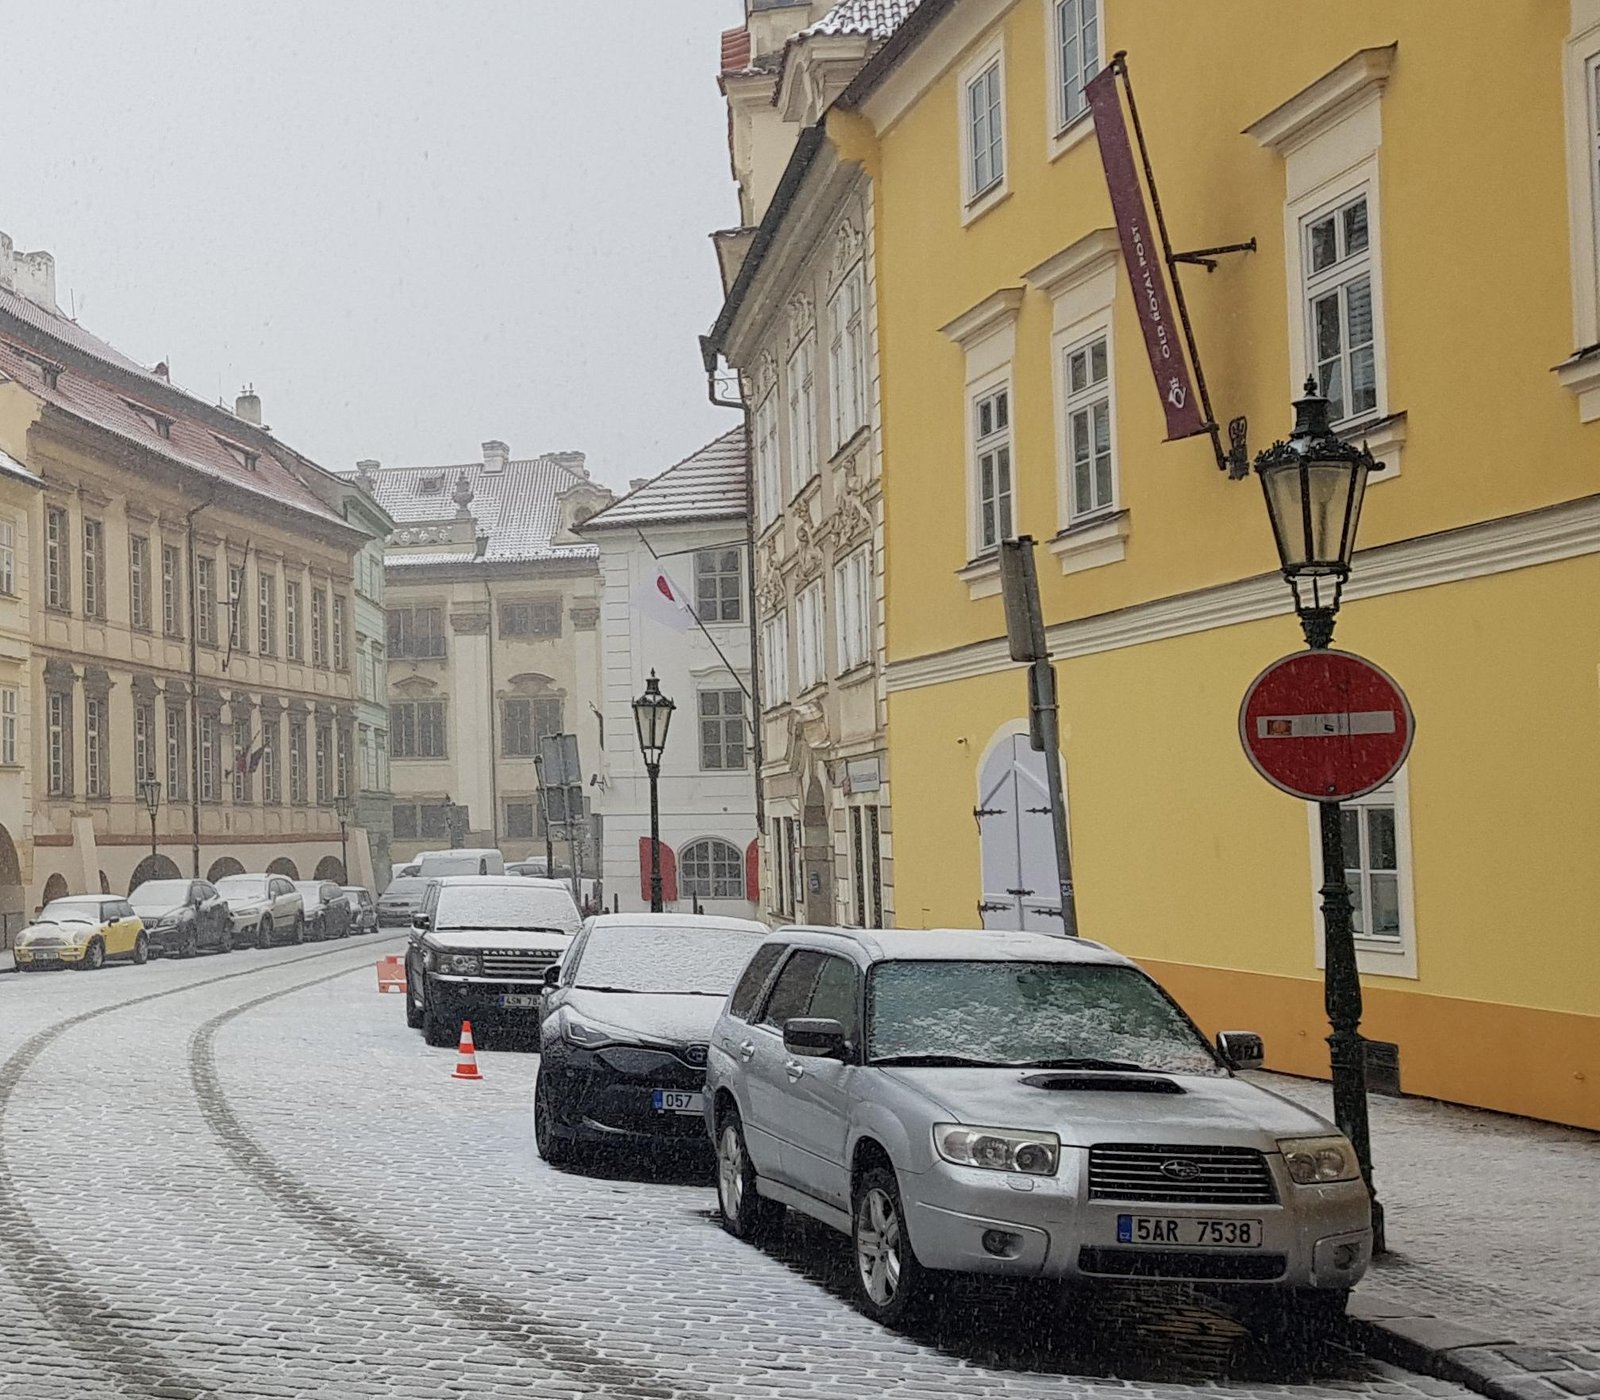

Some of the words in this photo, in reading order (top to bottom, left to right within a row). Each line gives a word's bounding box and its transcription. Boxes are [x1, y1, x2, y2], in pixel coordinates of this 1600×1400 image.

[1131, 226, 1147, 267] POST
[1142, 270, 1161, 321] ROYAL
[1157, 325, 1170, 358] OLD
[666, 1094, 692, 1108] 057
[1137, 1219, 1179, 1242] 5AR
[1197, 1221, 1250, 1243] 7538
